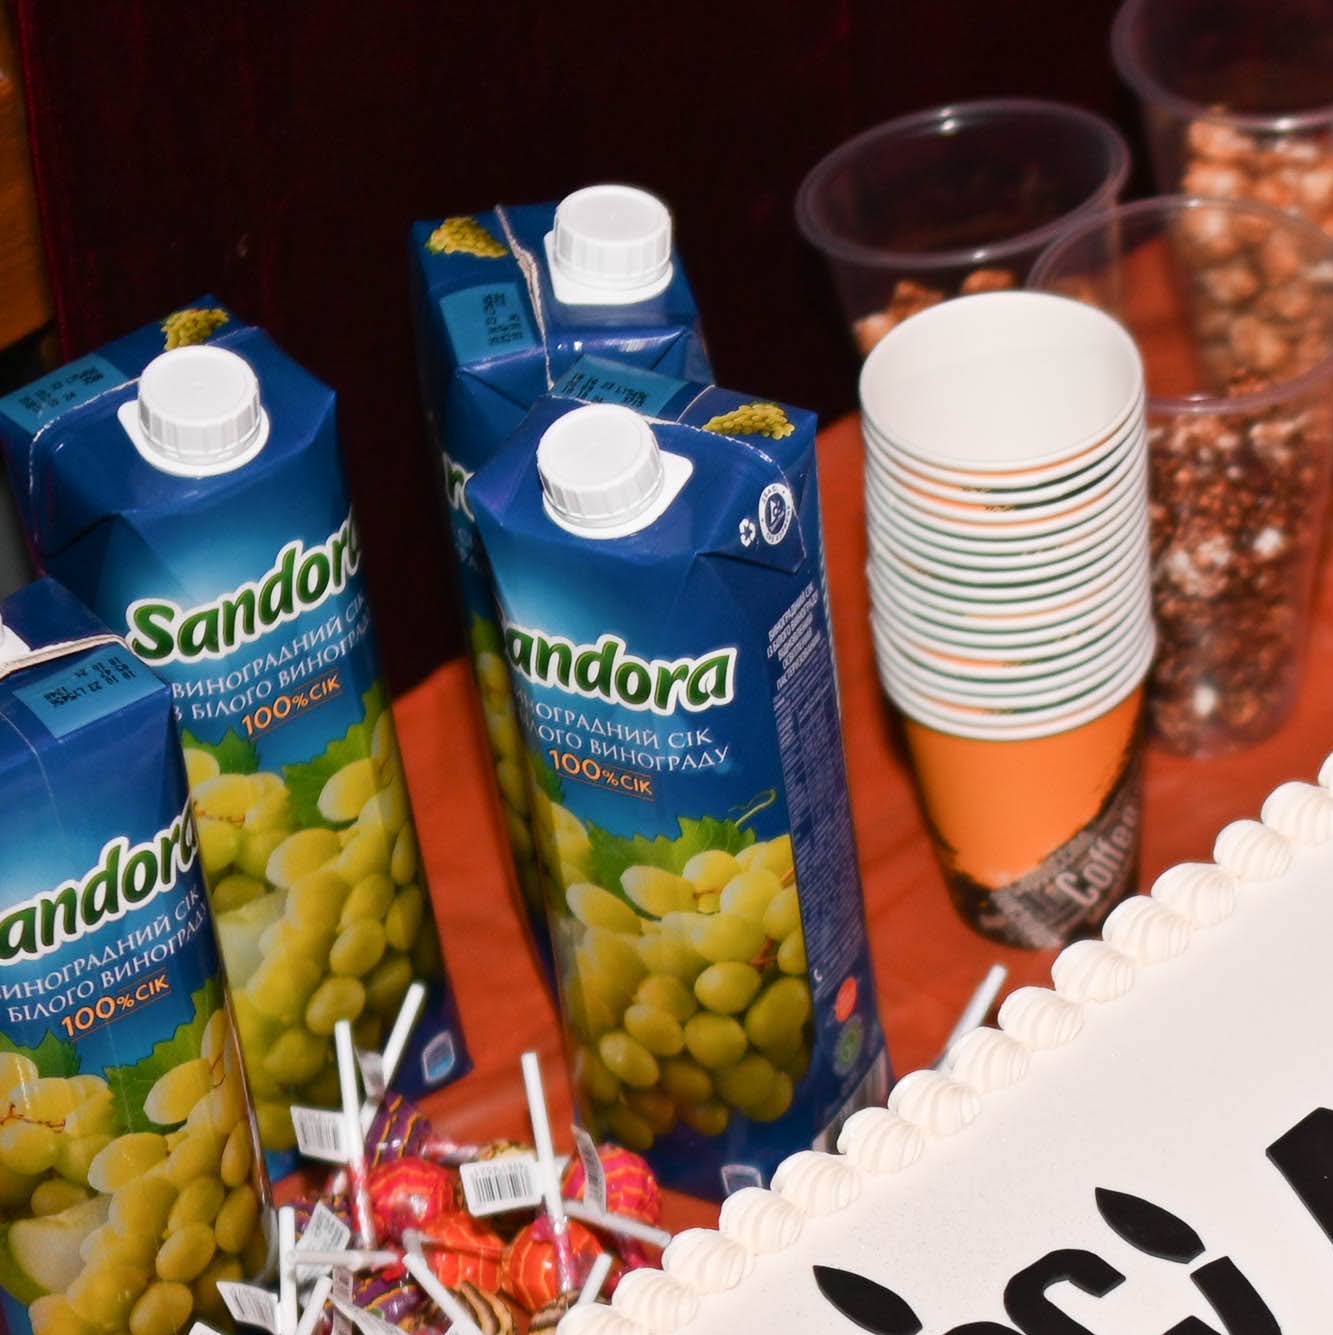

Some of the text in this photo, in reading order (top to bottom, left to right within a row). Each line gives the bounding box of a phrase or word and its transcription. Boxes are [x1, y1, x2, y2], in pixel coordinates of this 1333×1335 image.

[172, 616, 343, 699] ВИНОГРАДНИЙ
[503, 631, 737, 715] andora
[192, 682, 271, 720] БІЛОГО
[590, 738, 729, 772] ВИНОГРАДУ
[668, 727, 714, 751] СІК
[0, 800, 199, 963] andora
[0, 912, 171, 1001] ИНОГРАДНИЙ
[7, 980, 94, 1023] БІЛОГО
